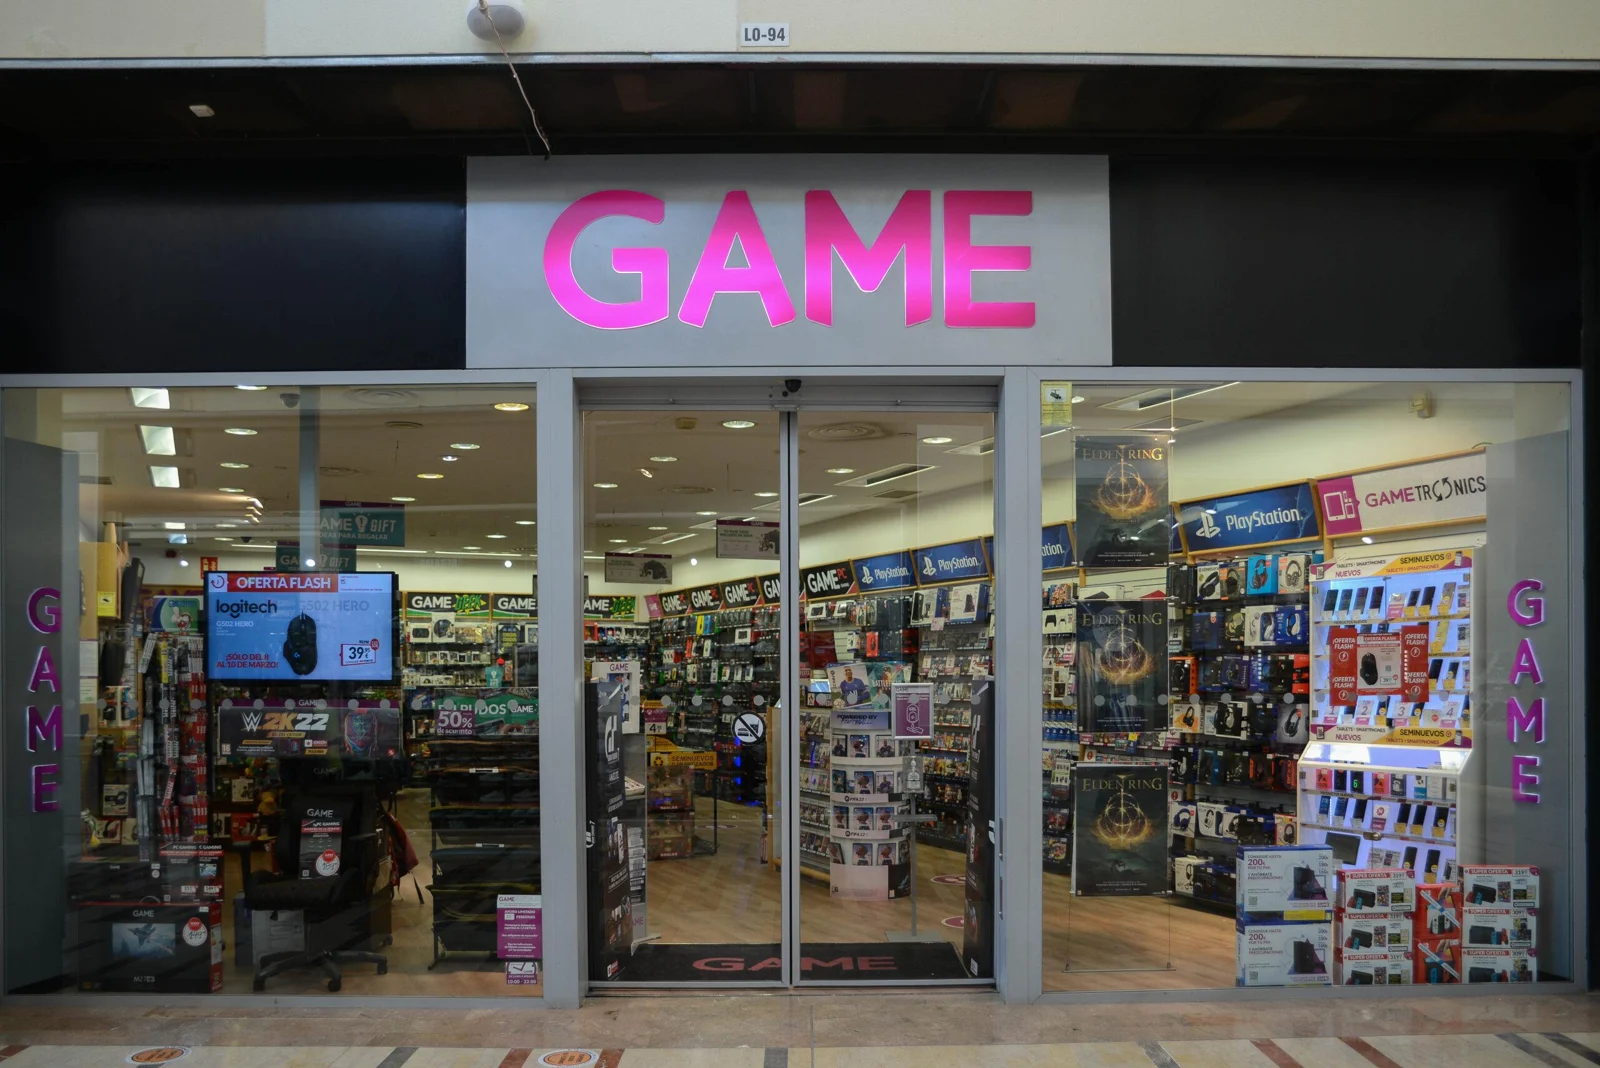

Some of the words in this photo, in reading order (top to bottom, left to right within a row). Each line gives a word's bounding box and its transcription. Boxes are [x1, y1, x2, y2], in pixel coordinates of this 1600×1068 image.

[744, 27, 786, 42] LO-94
[543, 189, 1036, 330] GAME
[1083, 448, 1125, 461] ELDEN
[1128, 448, 1163, 461] RING
[320, 518, 353, 531] AME
[370, 519, 397, 533] GIFT
[1226, 507, 1303, 533] PlayStation
[280, 555, 299, 565] GA
[938, 555, 980, 571] PlayStation
[1400, 553, 1445, 565] SEMINUEVOS
[807, 568, 840, 593] GAME
[837, 567, 848, 579] PC
[874, 565, 909, 582] PlayStation
[1335, 569, 1361, 578] NUEVOS
[236, 577, 288, 588] OFERTA
[290, 577, 331, 589] FLASH
[764, 579, 780, 599] GA
[691, 589, 714, 608] GAME
[725, 583, 751, 604] GAME
[216, 599, 278, 618] logitech
[333, 601, 370, 612] HERO
[412, 596, 453, 609] GAME
[497, 597, 536, 610] GAME
[584, 599, 610, 611] AME
[662, 595, 682, 612] GAME
[1082, 612, 1125, 626] ELDEN
[1128, 612, 1163, 625] RING
[249, 653, 263, 661] DEL
[264, 653, 269, 661] 8
[348, 646, 364, 659] 39
[609, 663, 629, 672] GAME
[1507, 579, 1545, 804] GAME
[27, 586, 63, 813] GAME
[1361, 706, 1368, 716] 2
[1398, 706, 1405, 716] 3
[1446, 707, 1454, 717] 4
[262, 712, 330, 731] 2K22
[437, 711, 473, 728] 50%
[649, 723, 656, 732] 4
[1400, 729, 1445, 737] SEMINUEVOS
[1335, 733, 1361, 741] NUEVOS
[313, 767, 338, 776] GAME
[1082, 777, 1125, 791] ELDEN
[1128, 777, 1163, 791] RING
[307, 808, 334, 818] GAME
[132, 909, 155, 918] GAME
[631, 916, 645, 925] AME
[692, 956, 898, 972] GAME
